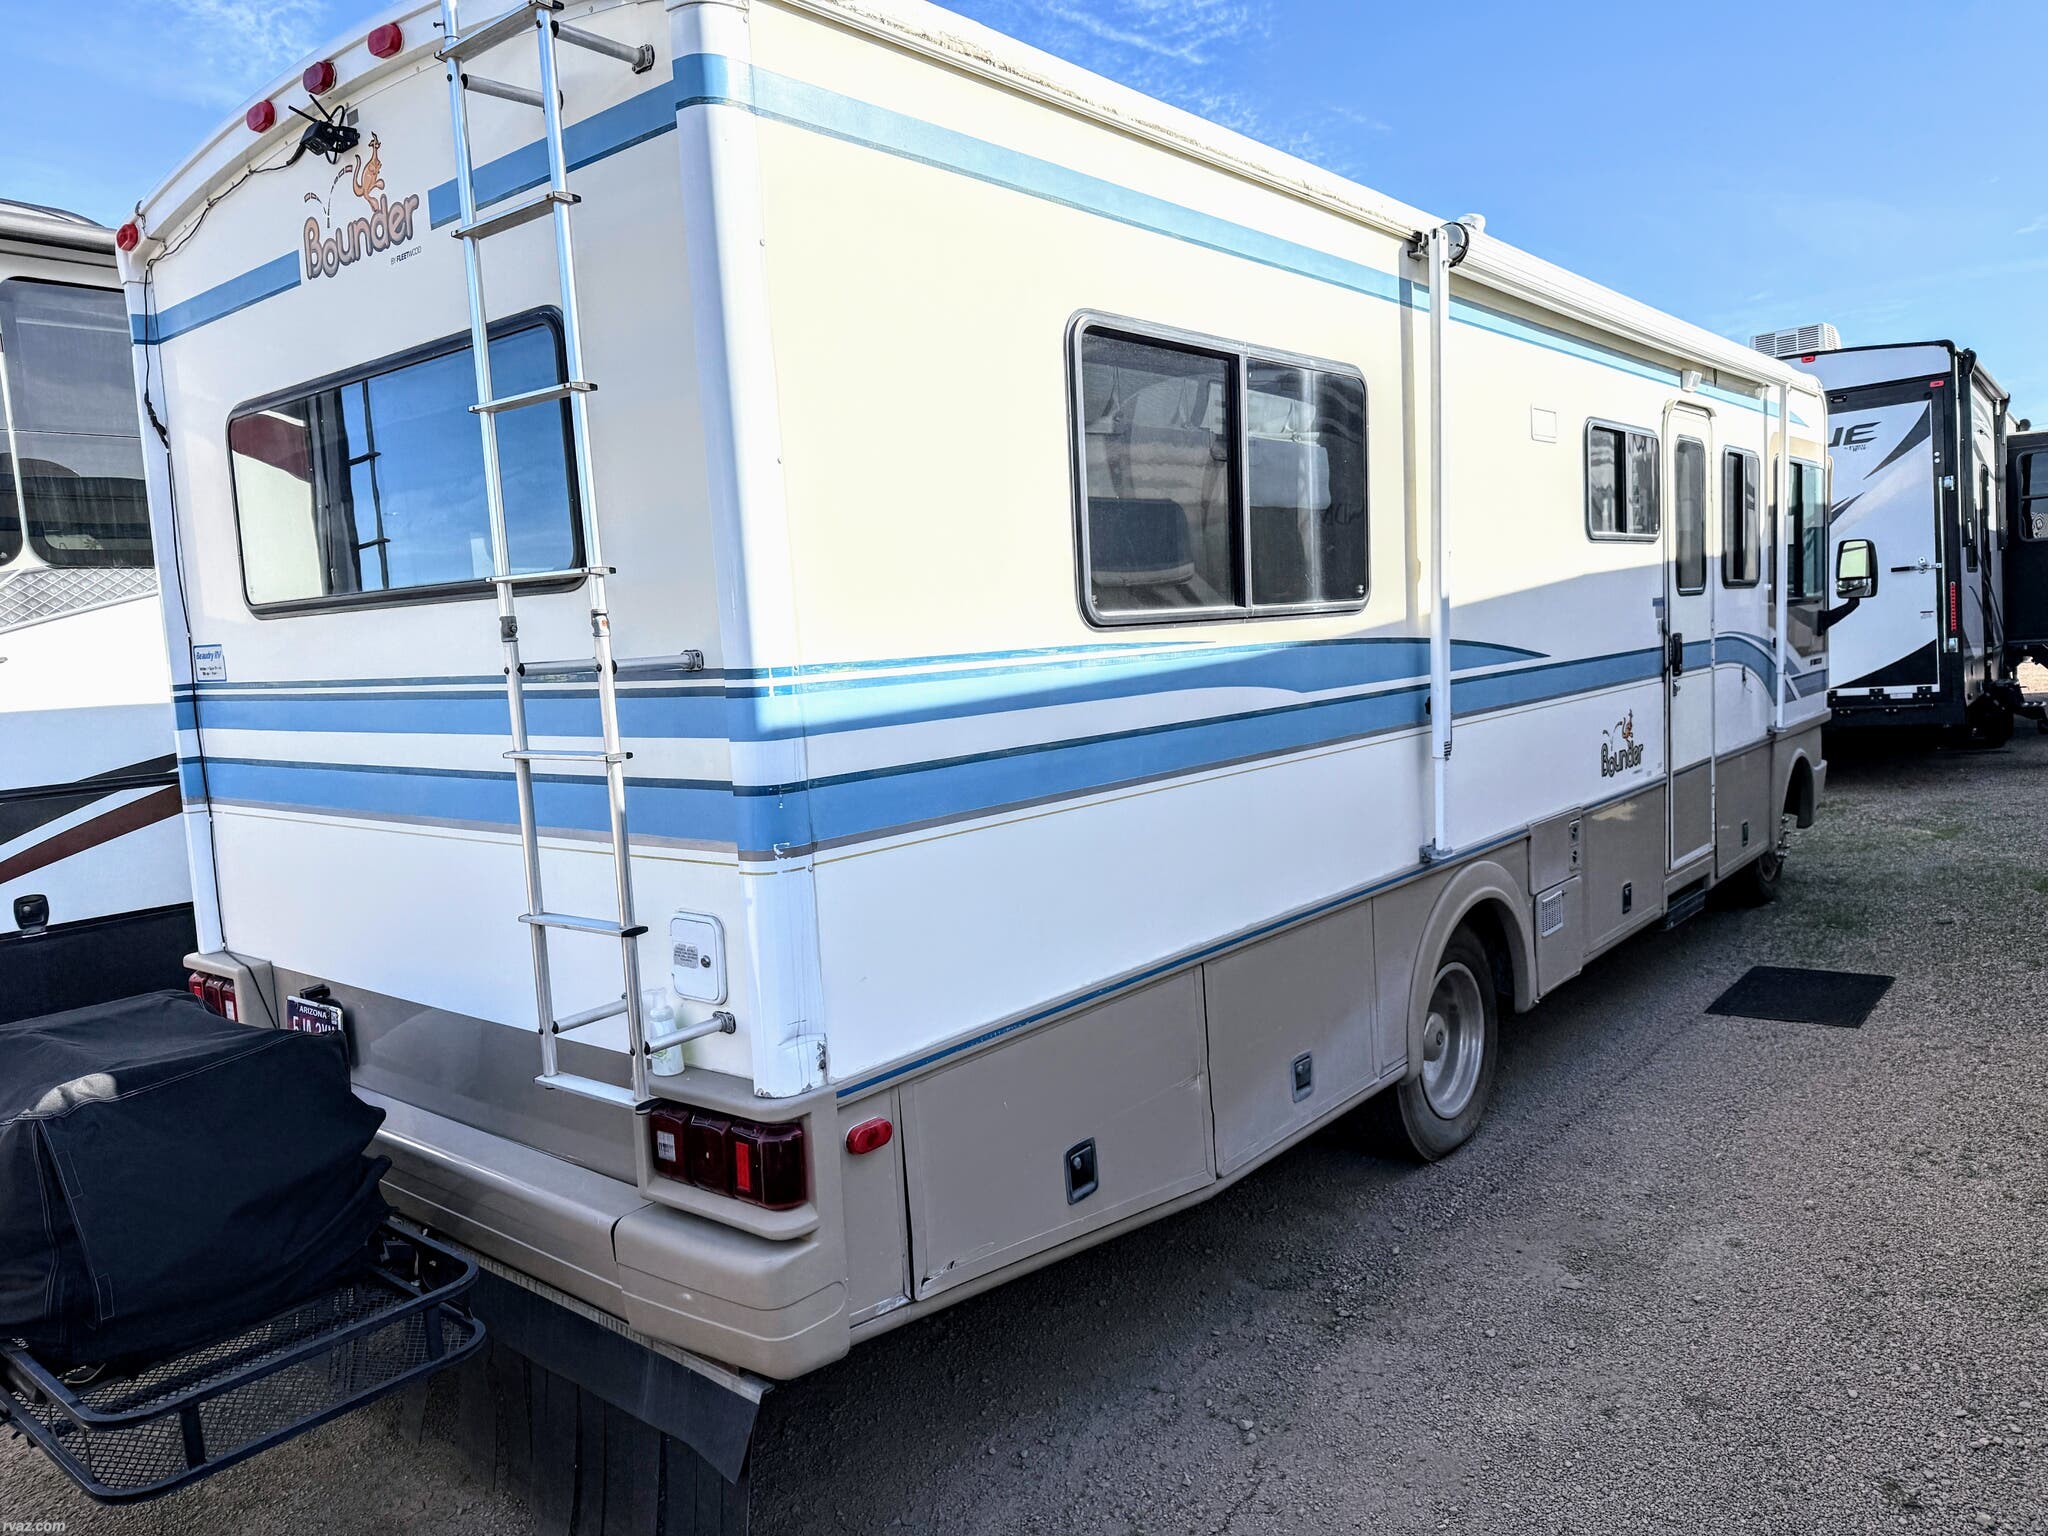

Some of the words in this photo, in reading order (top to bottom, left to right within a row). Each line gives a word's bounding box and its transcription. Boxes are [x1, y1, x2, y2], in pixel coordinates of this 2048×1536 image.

[303, 193, 420, 280] Bounder
[1601, 740, 1644, 777] Bounder
[299, 1005, 328, 1020] ARIZONA
